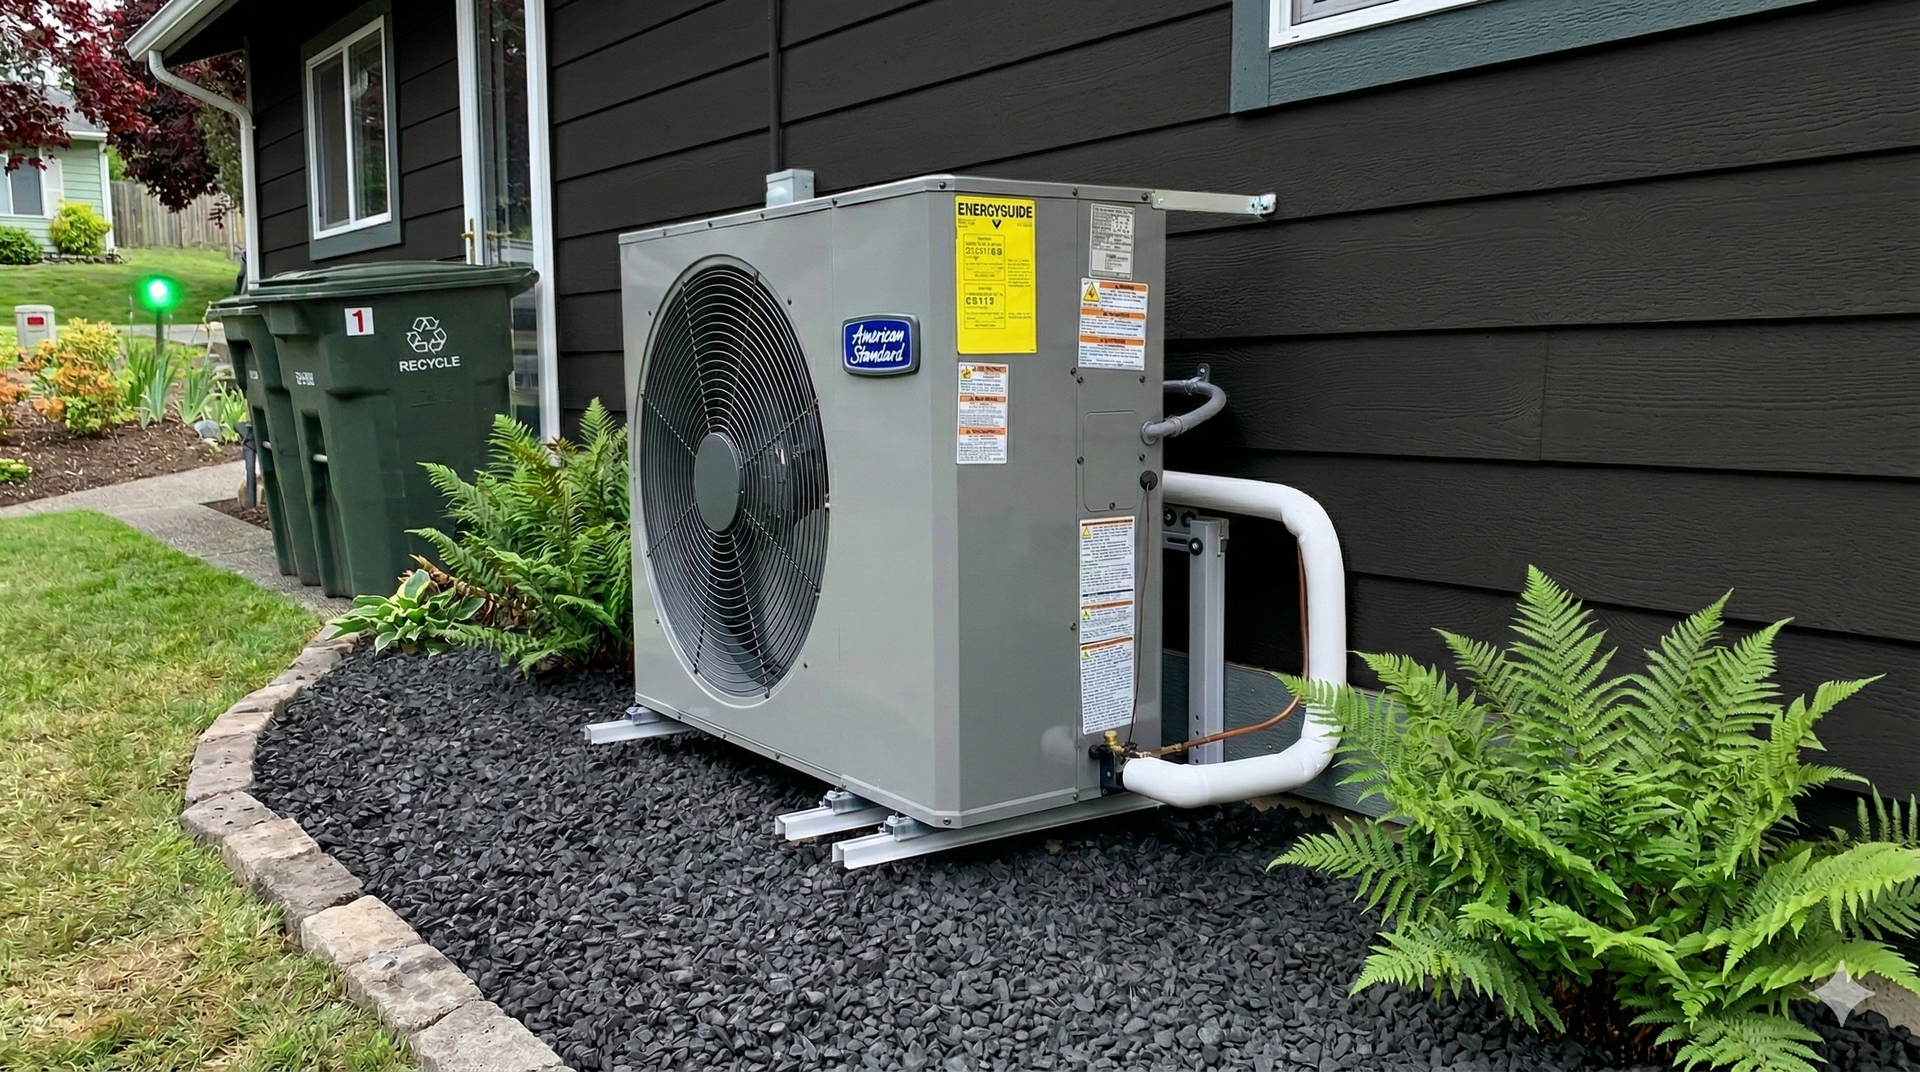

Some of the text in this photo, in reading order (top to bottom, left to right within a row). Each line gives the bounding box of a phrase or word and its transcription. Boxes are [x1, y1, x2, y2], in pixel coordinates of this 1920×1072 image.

[352, 309, 364, 333] 1
[851, 324, 905, 345] American
[850, 342, 905, 364] Standard
[399, 356, 461, 373] RECYCLE
